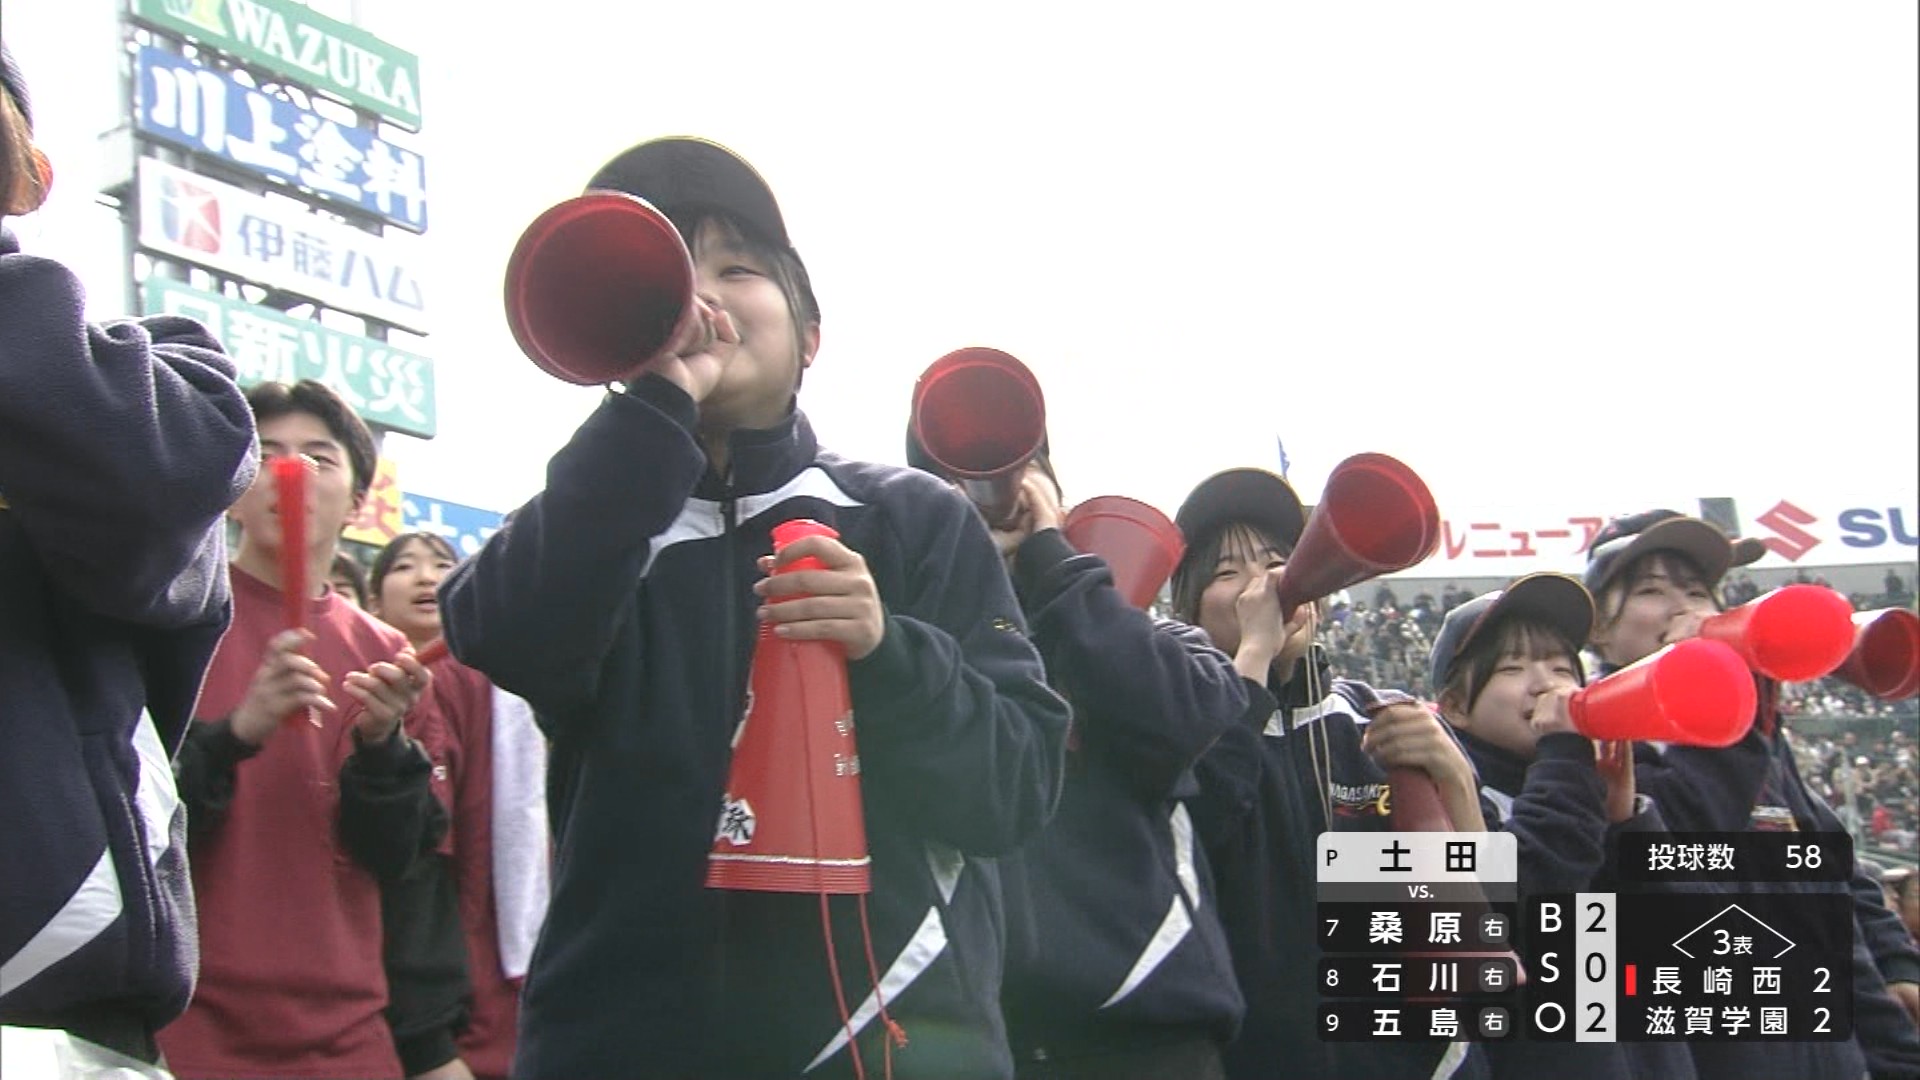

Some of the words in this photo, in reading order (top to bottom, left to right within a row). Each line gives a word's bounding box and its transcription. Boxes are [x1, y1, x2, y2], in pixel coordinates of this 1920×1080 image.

[226, 0, 420, 116] WAZUKA
[151, 66, 426, 223] 川上塗料
[238, 213, 425, 311] 伊藤ハム
